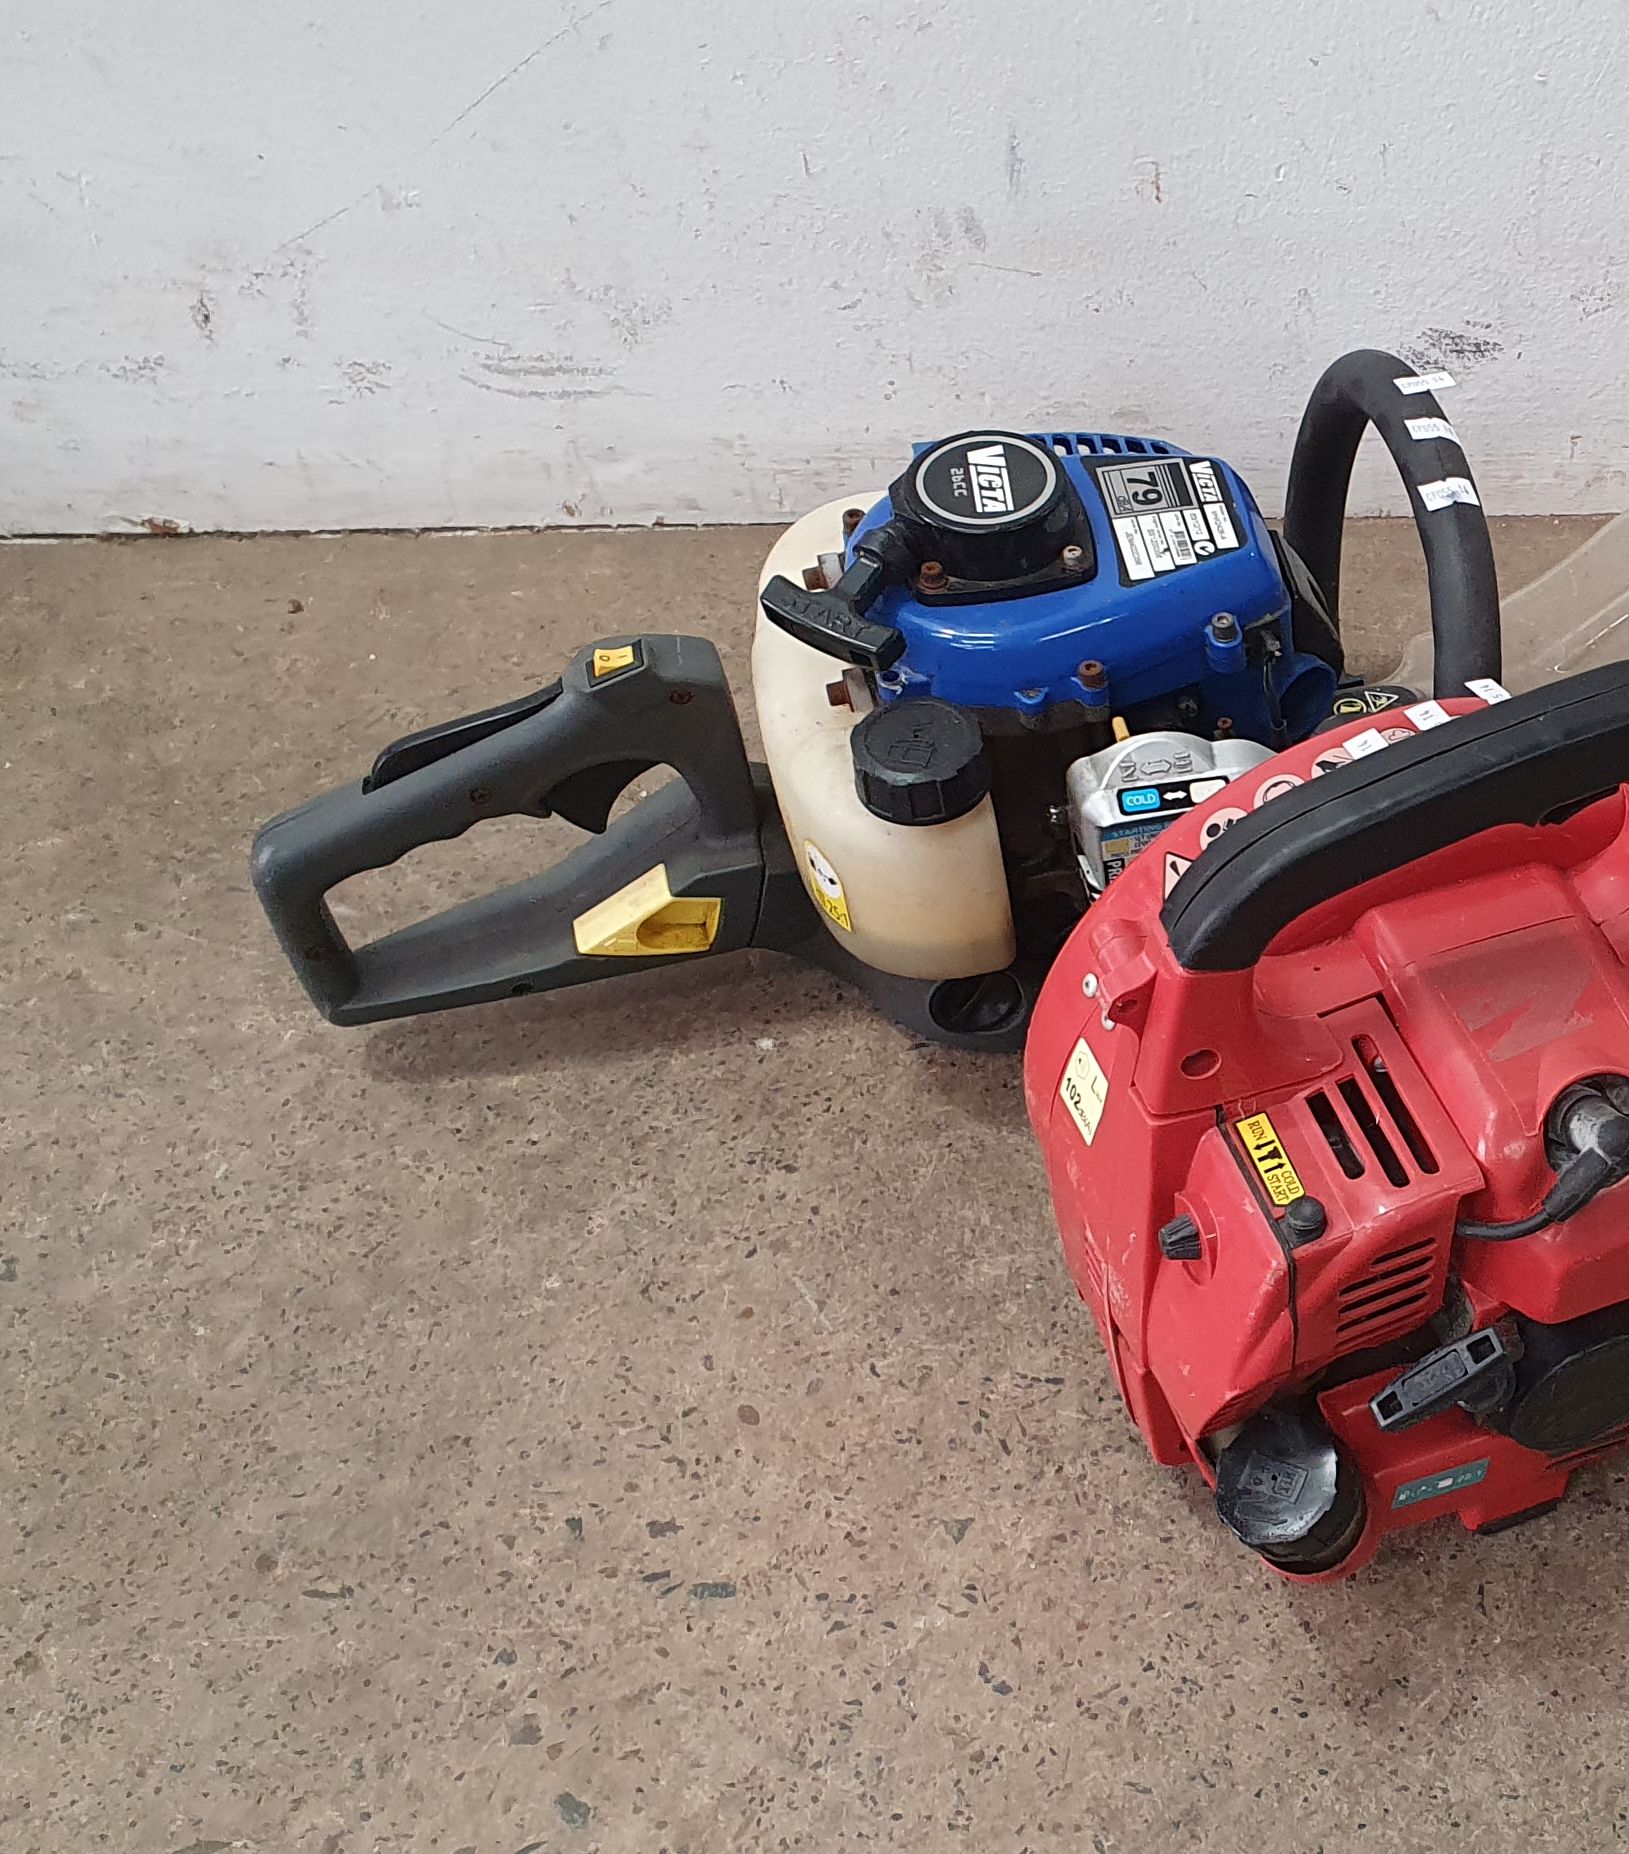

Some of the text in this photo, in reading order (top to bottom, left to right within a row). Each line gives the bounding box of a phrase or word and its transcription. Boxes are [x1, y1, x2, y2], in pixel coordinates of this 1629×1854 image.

[967, 444, 1015, 513] VICTA
[1126, 471, 1163, 506] 79
[1189, 460, 1223, 503] VICTA
[1125, 792, 1157, 808] COLD
[1247, 1119, 1268, 1141] RUN
[1266, 1173, 1290, 1202] START
[1281, 1170, 1300, 1195] COLD
